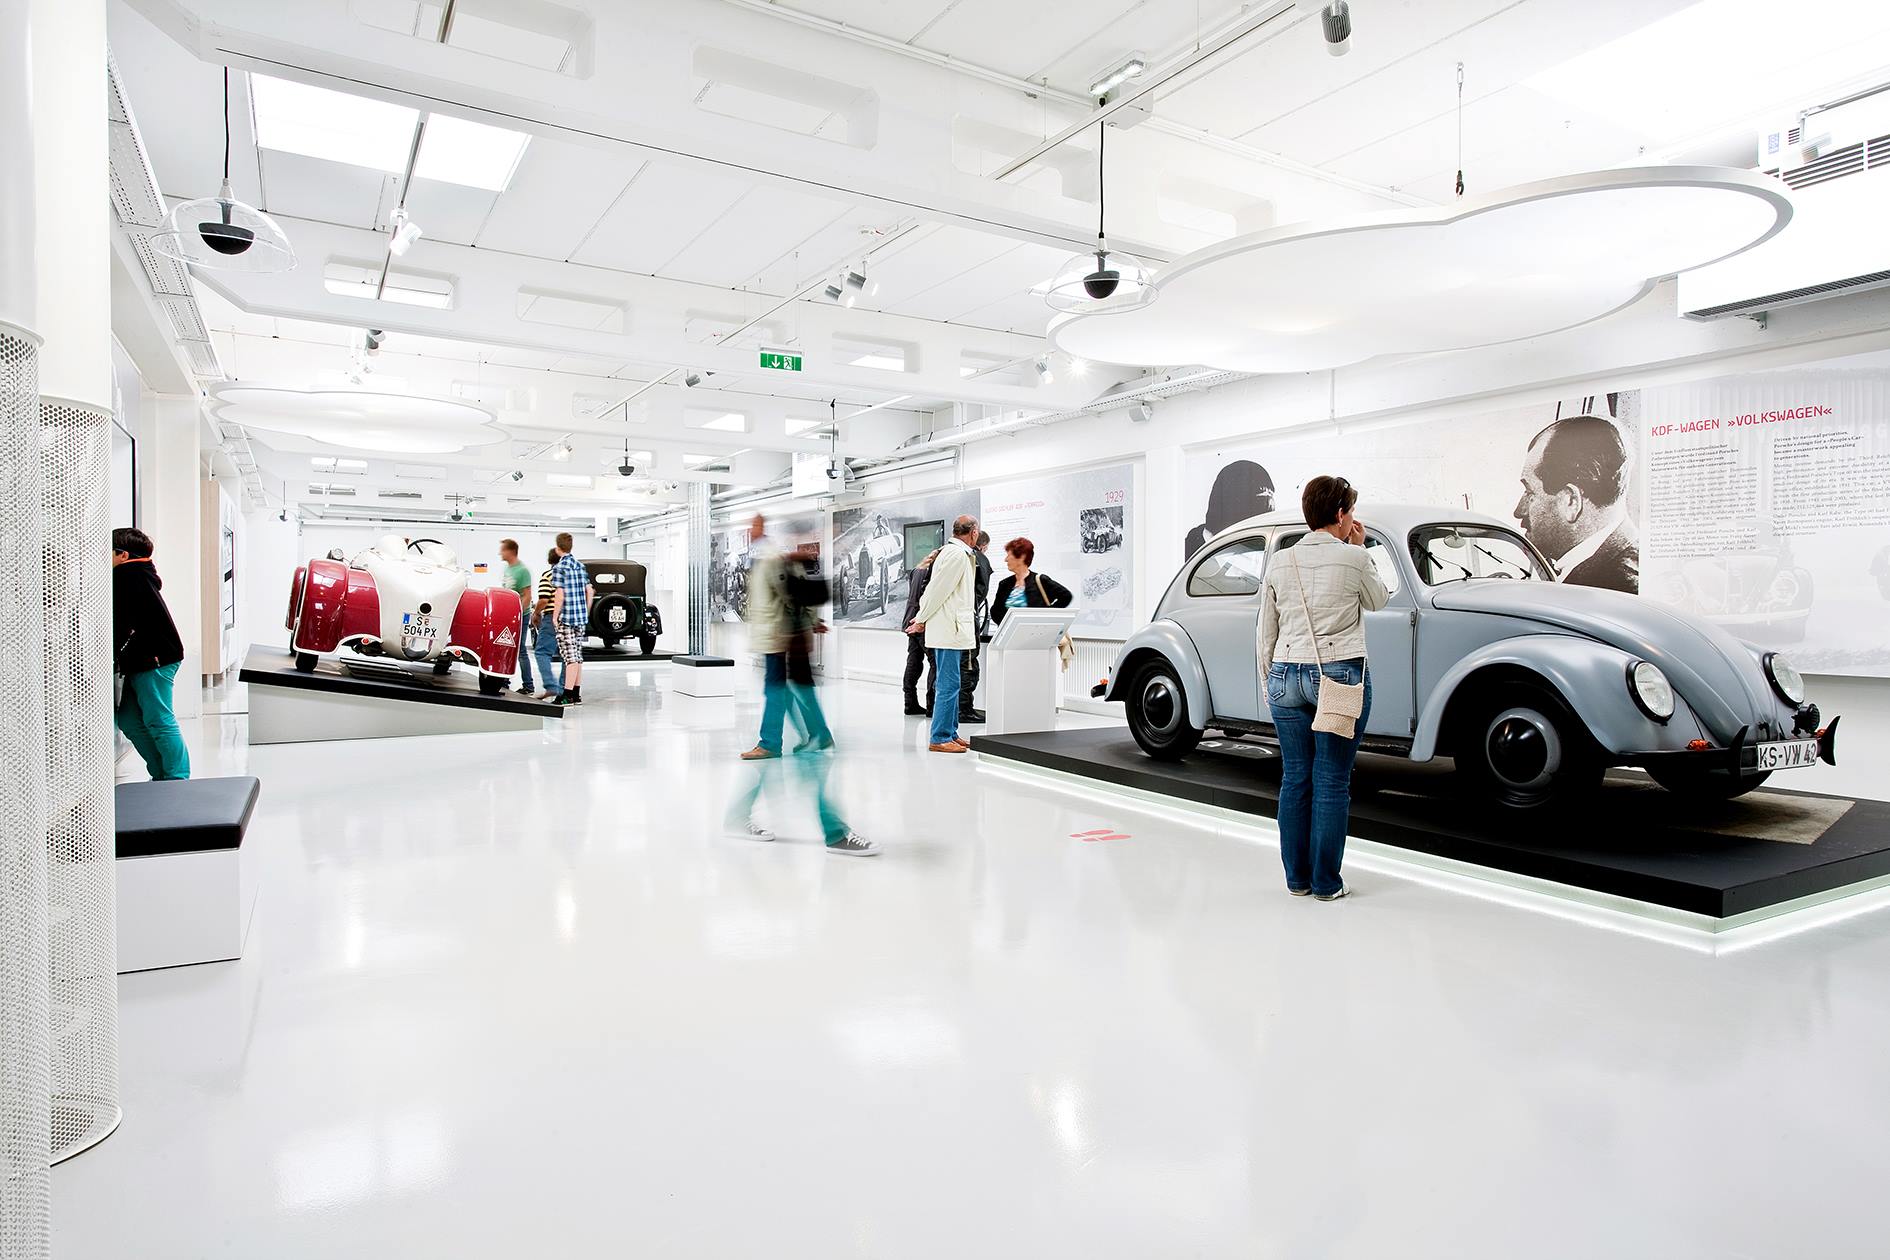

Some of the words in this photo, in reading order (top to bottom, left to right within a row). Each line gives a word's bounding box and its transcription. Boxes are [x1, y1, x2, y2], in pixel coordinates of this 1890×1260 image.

[1651, 419, 1720, 437] KDF-WAGEN
[1727, 405, 1833, 427] »VOLKSWAGEN«
[1105, 490, 1124, 503] 1929
[404, 625, 422, 636] 504
[424, 628, 437, 638] PX
[1759, 745, 1802, 768] KS-VW
[1804, 743, 1817, 764] 42
